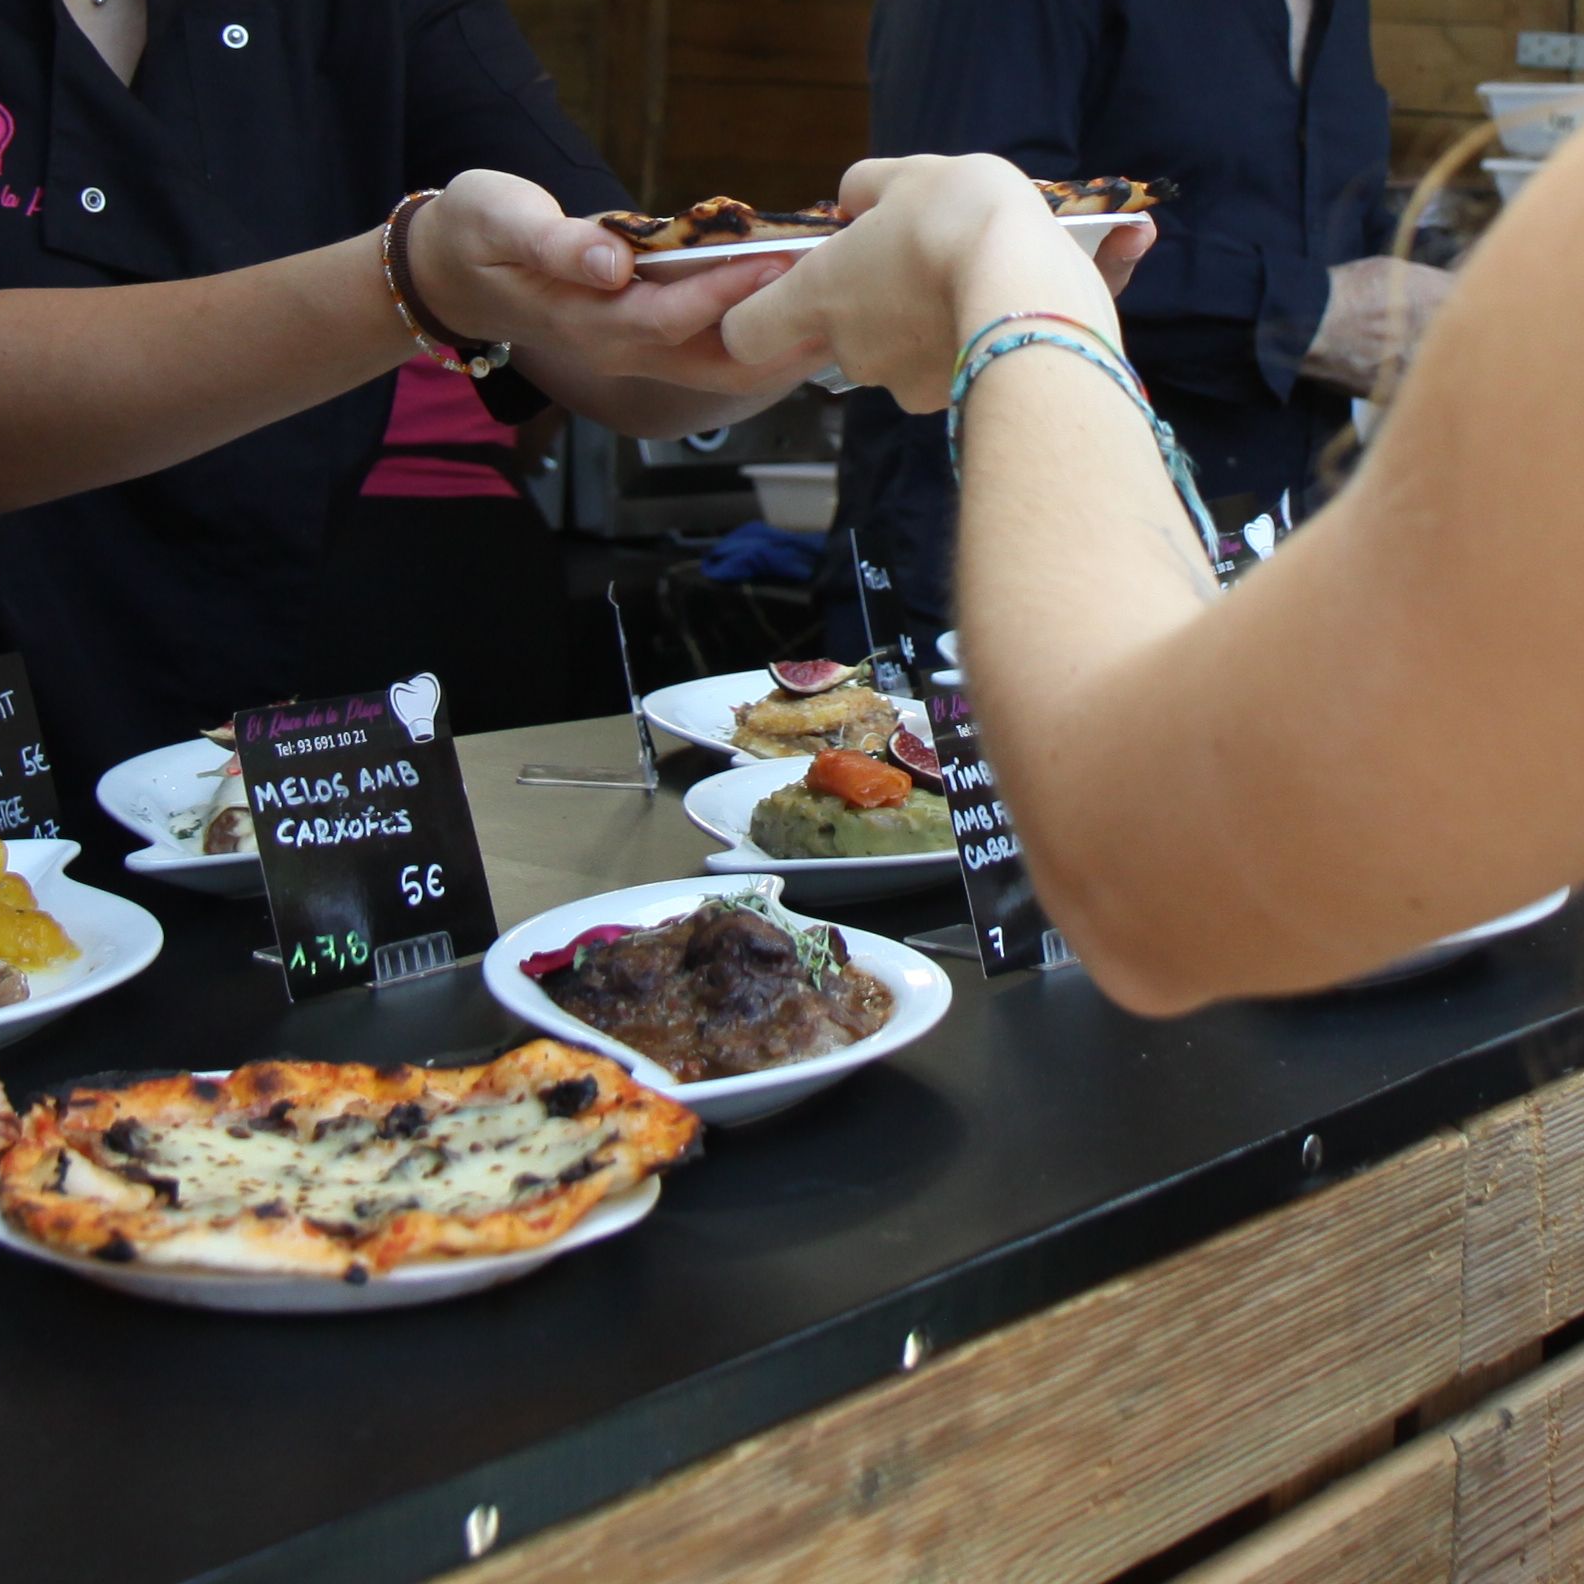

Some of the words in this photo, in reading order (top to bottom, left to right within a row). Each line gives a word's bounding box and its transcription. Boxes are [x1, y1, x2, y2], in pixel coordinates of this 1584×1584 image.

[21, 743, 51, 777] 5€
[275, 741, 297, 757] Tel:
[297, 738, 313, 754] 93
[314, 735, 336, 750] 691
[337, 732, 352, 747] 10
[352, 729, 368, 744] 21
[254, 772, 350, 813] MELOS
[359, 760, 420, 794] AMB
[953, 805, 994, 837] AMB
[400, 864, 446, 906] 5€
[988, 925, 1006, 959] 7
